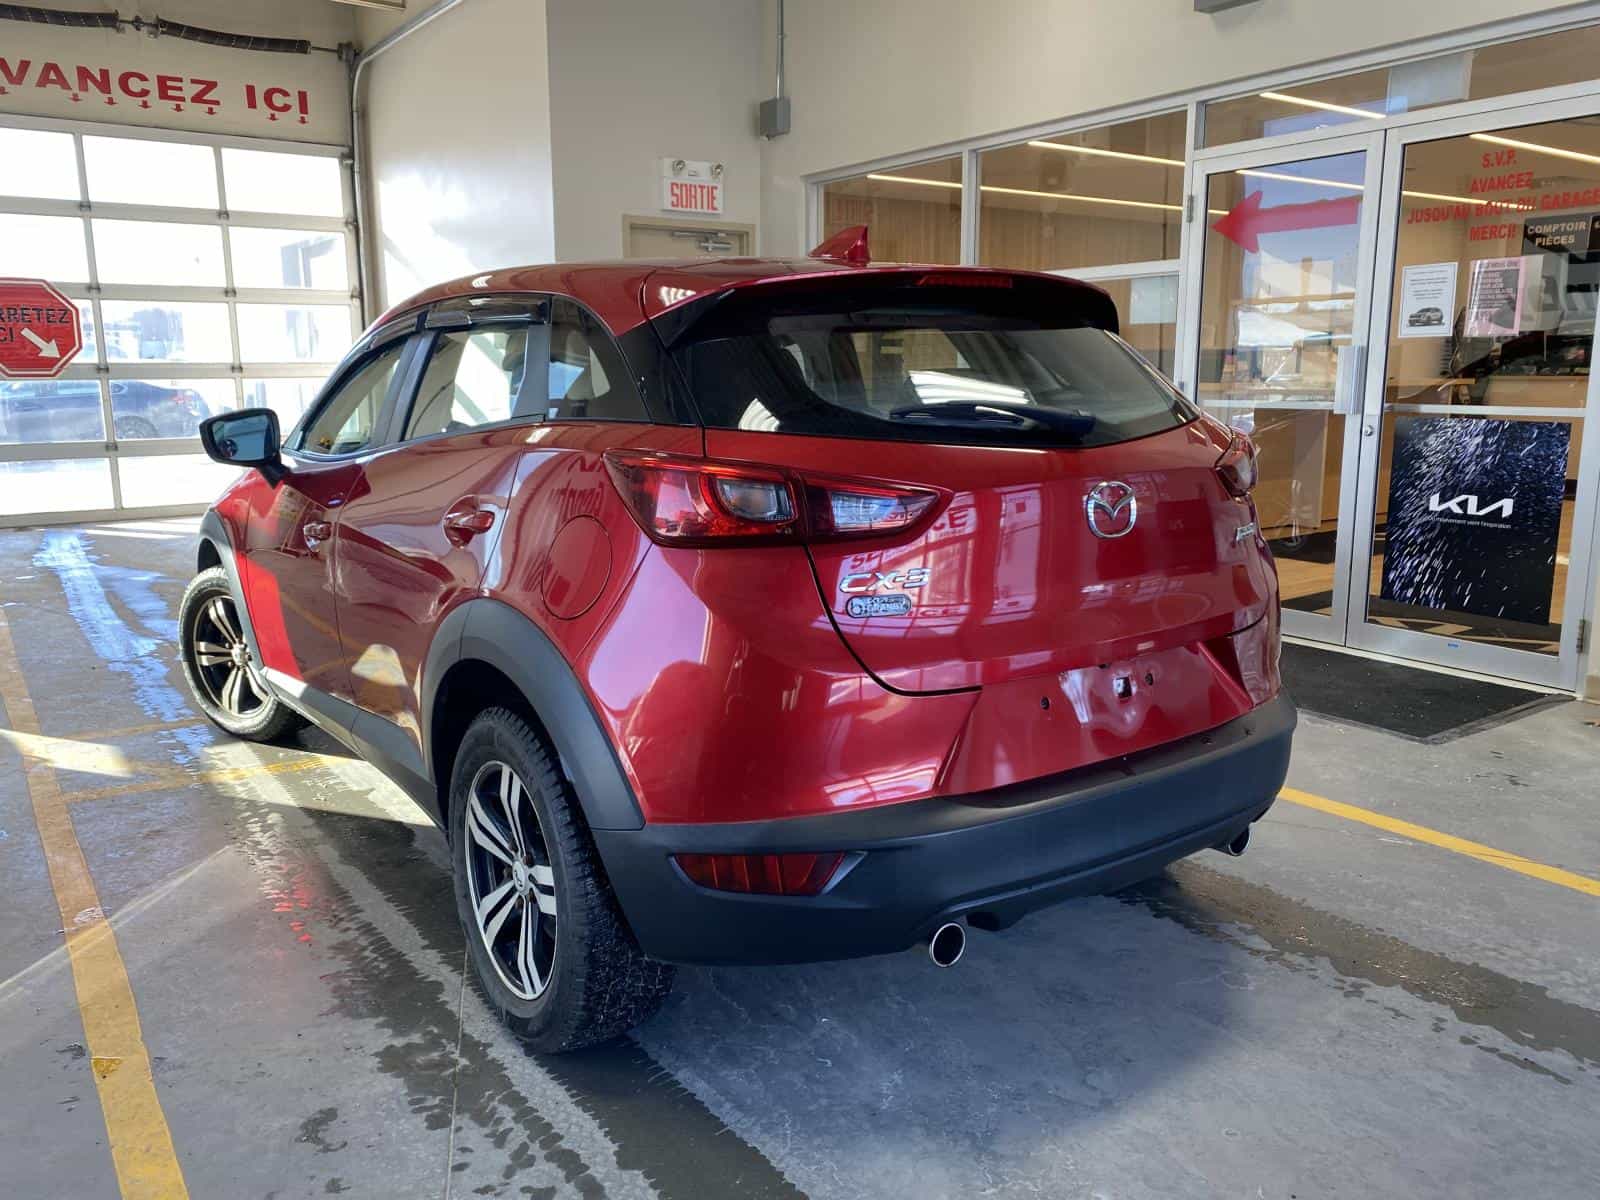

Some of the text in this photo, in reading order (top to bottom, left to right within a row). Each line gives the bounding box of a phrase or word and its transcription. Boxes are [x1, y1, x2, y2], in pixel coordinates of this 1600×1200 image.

[245, 84, 308, 115] ICI
[1482, 150, 1517, 168] S.V.P.
[1469, 171, 1534, 193] AVANCEZ
[670, 182, 718, 211] SORTIE
[1527, 221, 1587, 234] COMPTOIR
[839, 568, 931, 593] CX-3
